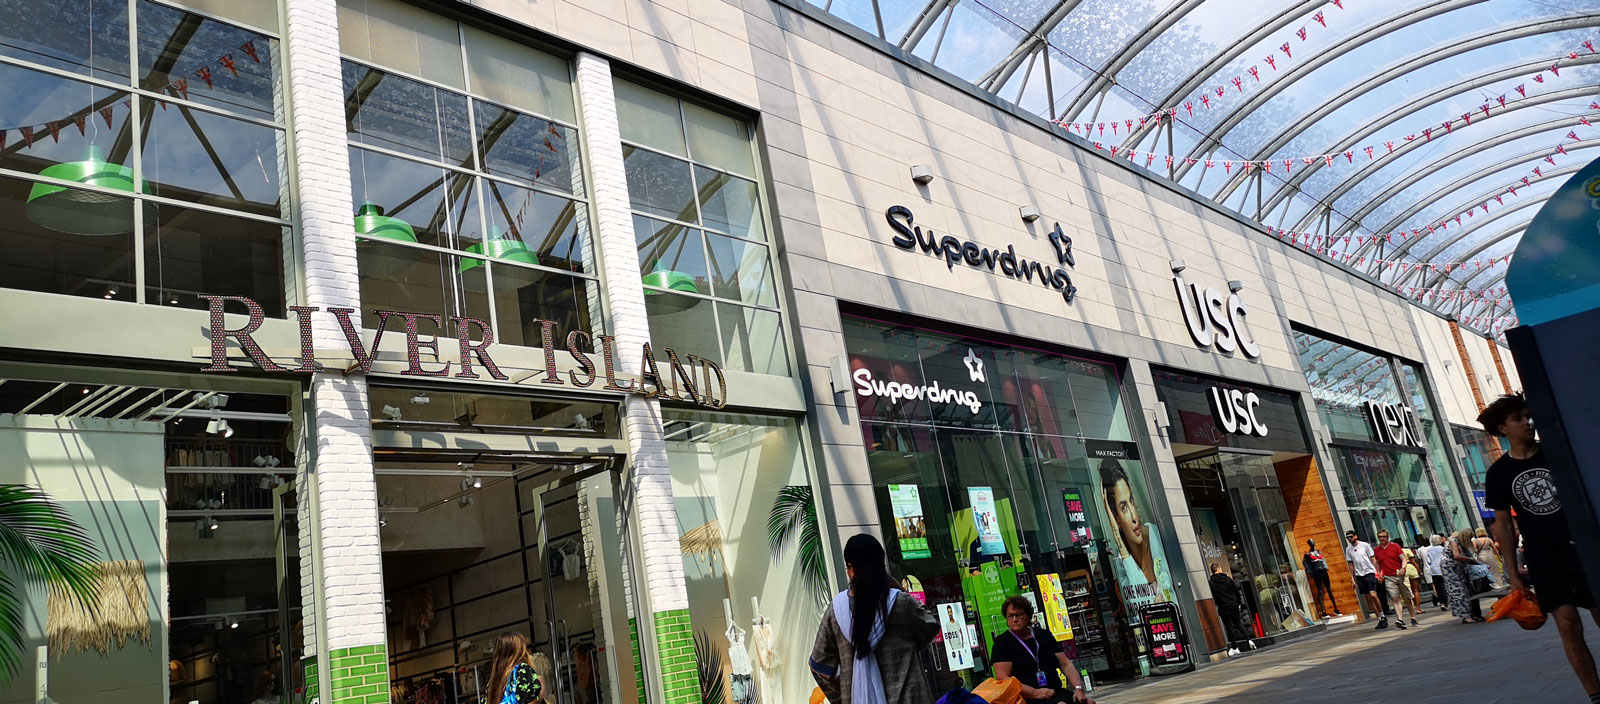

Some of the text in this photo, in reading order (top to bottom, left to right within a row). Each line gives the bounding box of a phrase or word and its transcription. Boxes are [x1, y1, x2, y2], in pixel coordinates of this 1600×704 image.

[885, 205, 1077, 302] Superdrug
[1173, 277, 1260, 359] USC
[197, 293, 727, 409] RIVER ISLAND
[853, 368, 981, 414] Superdrug
[1210, 386, 1268, 437] USC
[1366, 399, 1424, 448] next
[1066, 500, 1083, 512] SAVE
[1068, 512, 1086, 522] MORE
[1123, 585, 1136, 600] ONE
[1149, 617, 1173, 625] MEMBERS
[1151, 622, 1175, 634] SAVE
[944, 631, 959, 640] BOSS
[1153, 632, 1177, 642] MORE
